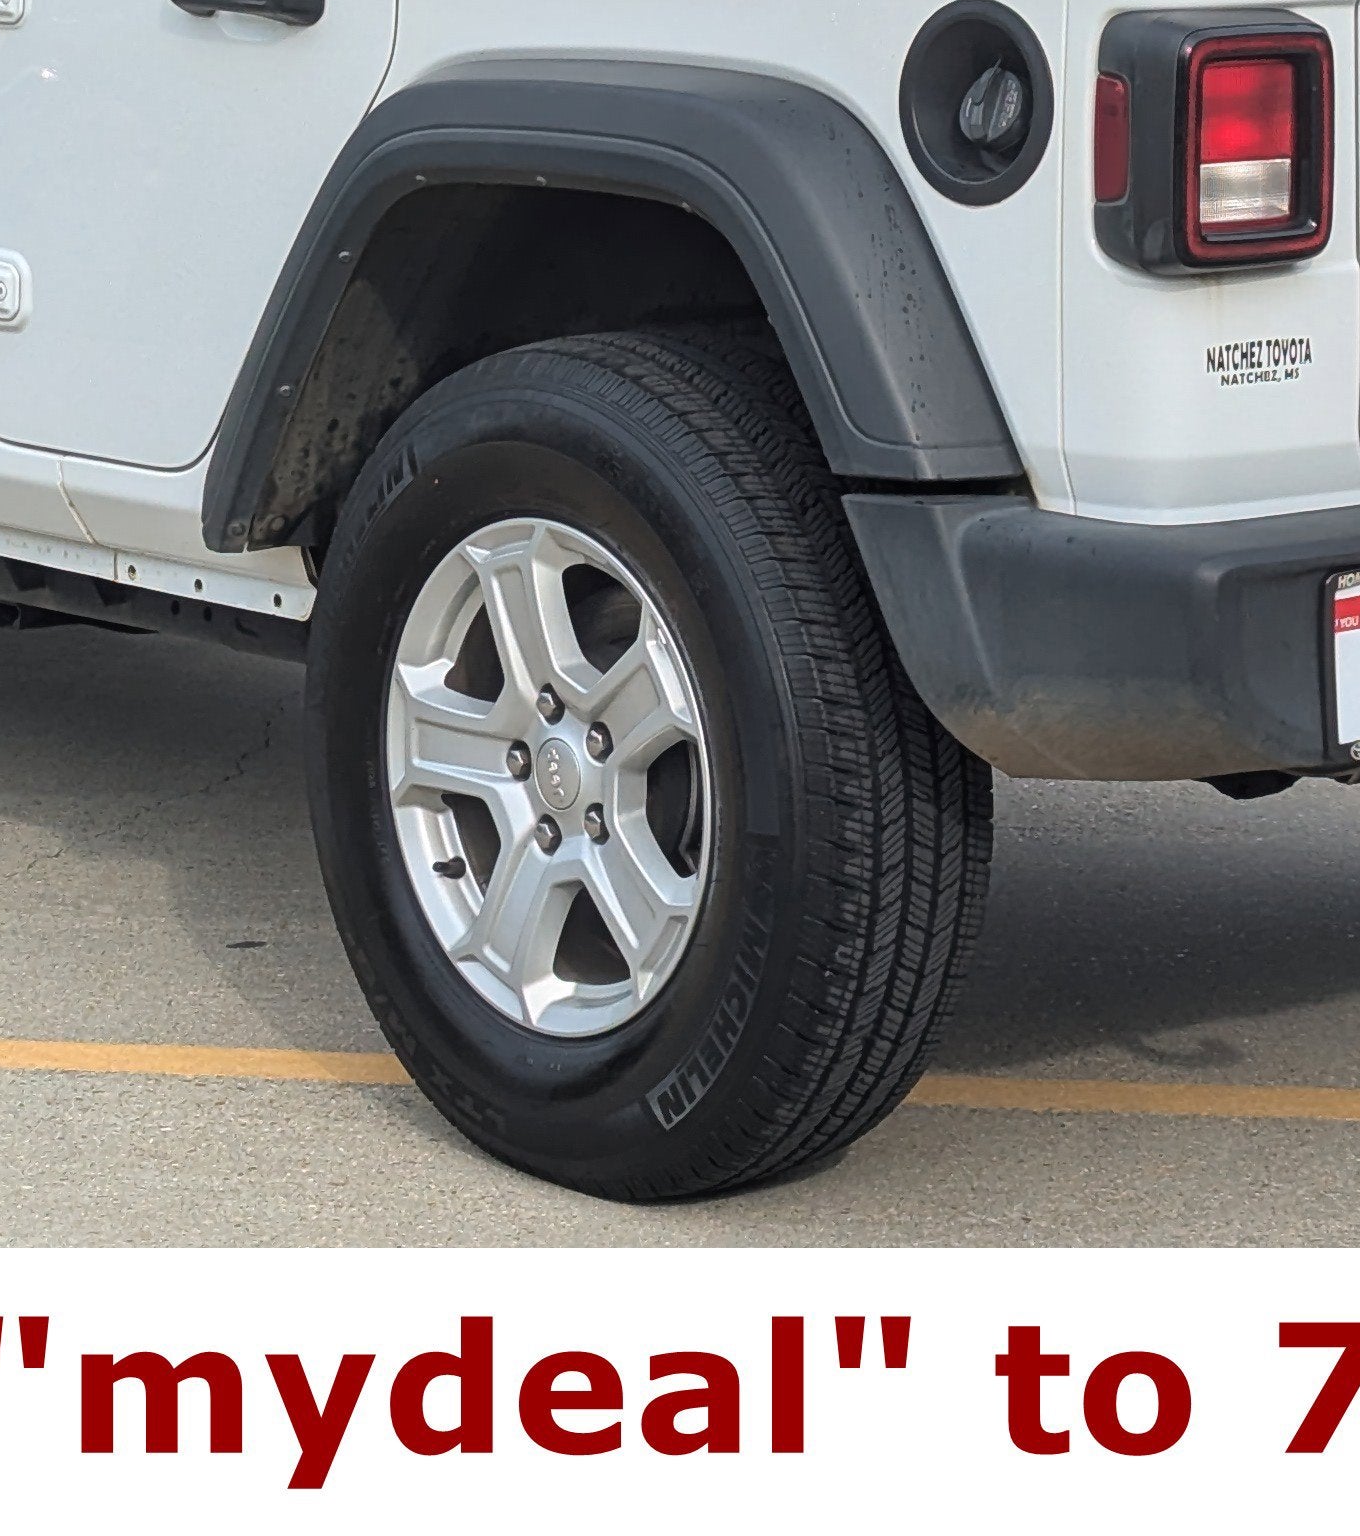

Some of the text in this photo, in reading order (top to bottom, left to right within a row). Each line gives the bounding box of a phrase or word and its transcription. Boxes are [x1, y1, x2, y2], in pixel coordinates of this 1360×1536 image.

[1206, 337, 1313, 373] NATCHEZ TOYOTA
[1340, 615, 1360, 629] YOU
